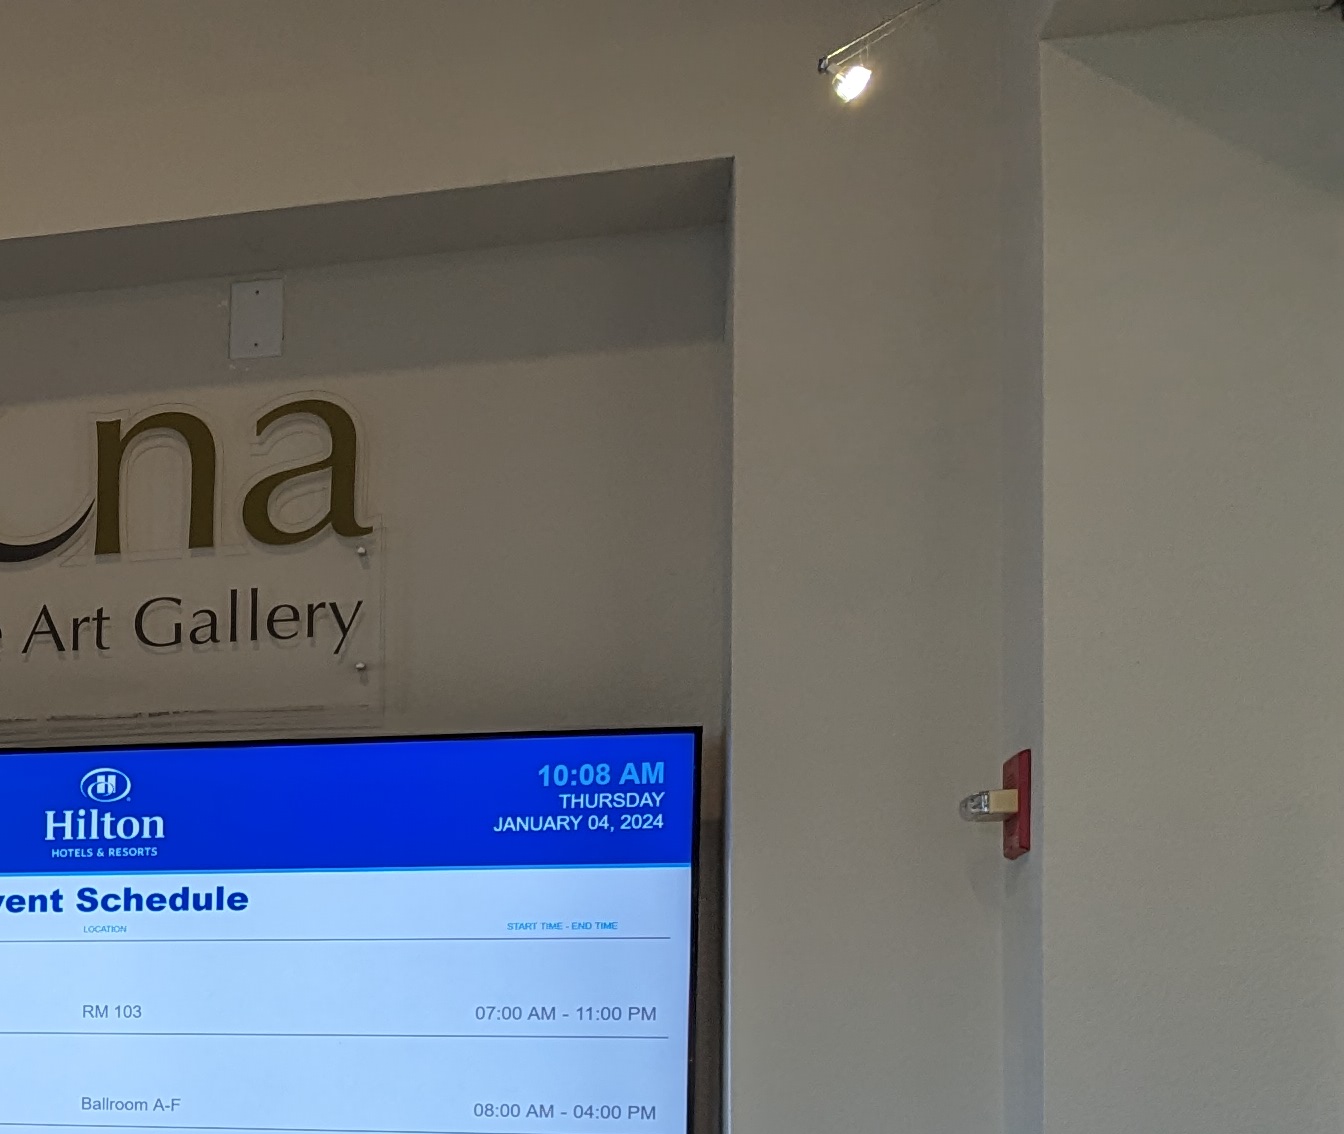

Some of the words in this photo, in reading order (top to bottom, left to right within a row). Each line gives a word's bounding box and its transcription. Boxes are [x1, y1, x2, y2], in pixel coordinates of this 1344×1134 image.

[21, 604, 110, 653] Art
[134, 587, 363, 655] Gallery
[538, 763, 611, 787] 10:08
[619, 761, 664, 785] AM
[559, 791, 665, 809] THURSDAY
[44, 808, 166, 841] Hilton
[493, 815, 582, 832] JANUARY
[588, 815, 615, 832] 04,
[620, 814, 664, 830] 2024
[52, 848, 93, 858] HOTELS
[96, 848, 105, 857] &
[108, 847, 158, 857] RESORTS
[76, 886, 249, 913] Schedule
[83, 925, 128, 934] LOCATION
[507, 922, 538, 930] START
[540, 921, 563, 930] TIME
[572, 921, 592, 930] END
[595, 921, 618, 930] TIME
[82, 1005, 109, 1018] RM
[114, 1005, 142, 1019] 103
[475, 1006, 522, 1021] 07:00
[527, 1006, 556, 1021] AM
[575, 1006, 622, 1021] 11:00
[628, 1007, 657, 1021] PM
[81, 1096, 148, 1111] Ballroom
[153, 1098, 181, 1112] A-F
[473, 1103, 521, 1118] 08:00
[526, 1104, 554, 1118] AM
[573, 1105, 621, 1120] 04:00
[627, 1105, 656, 1120] PM
